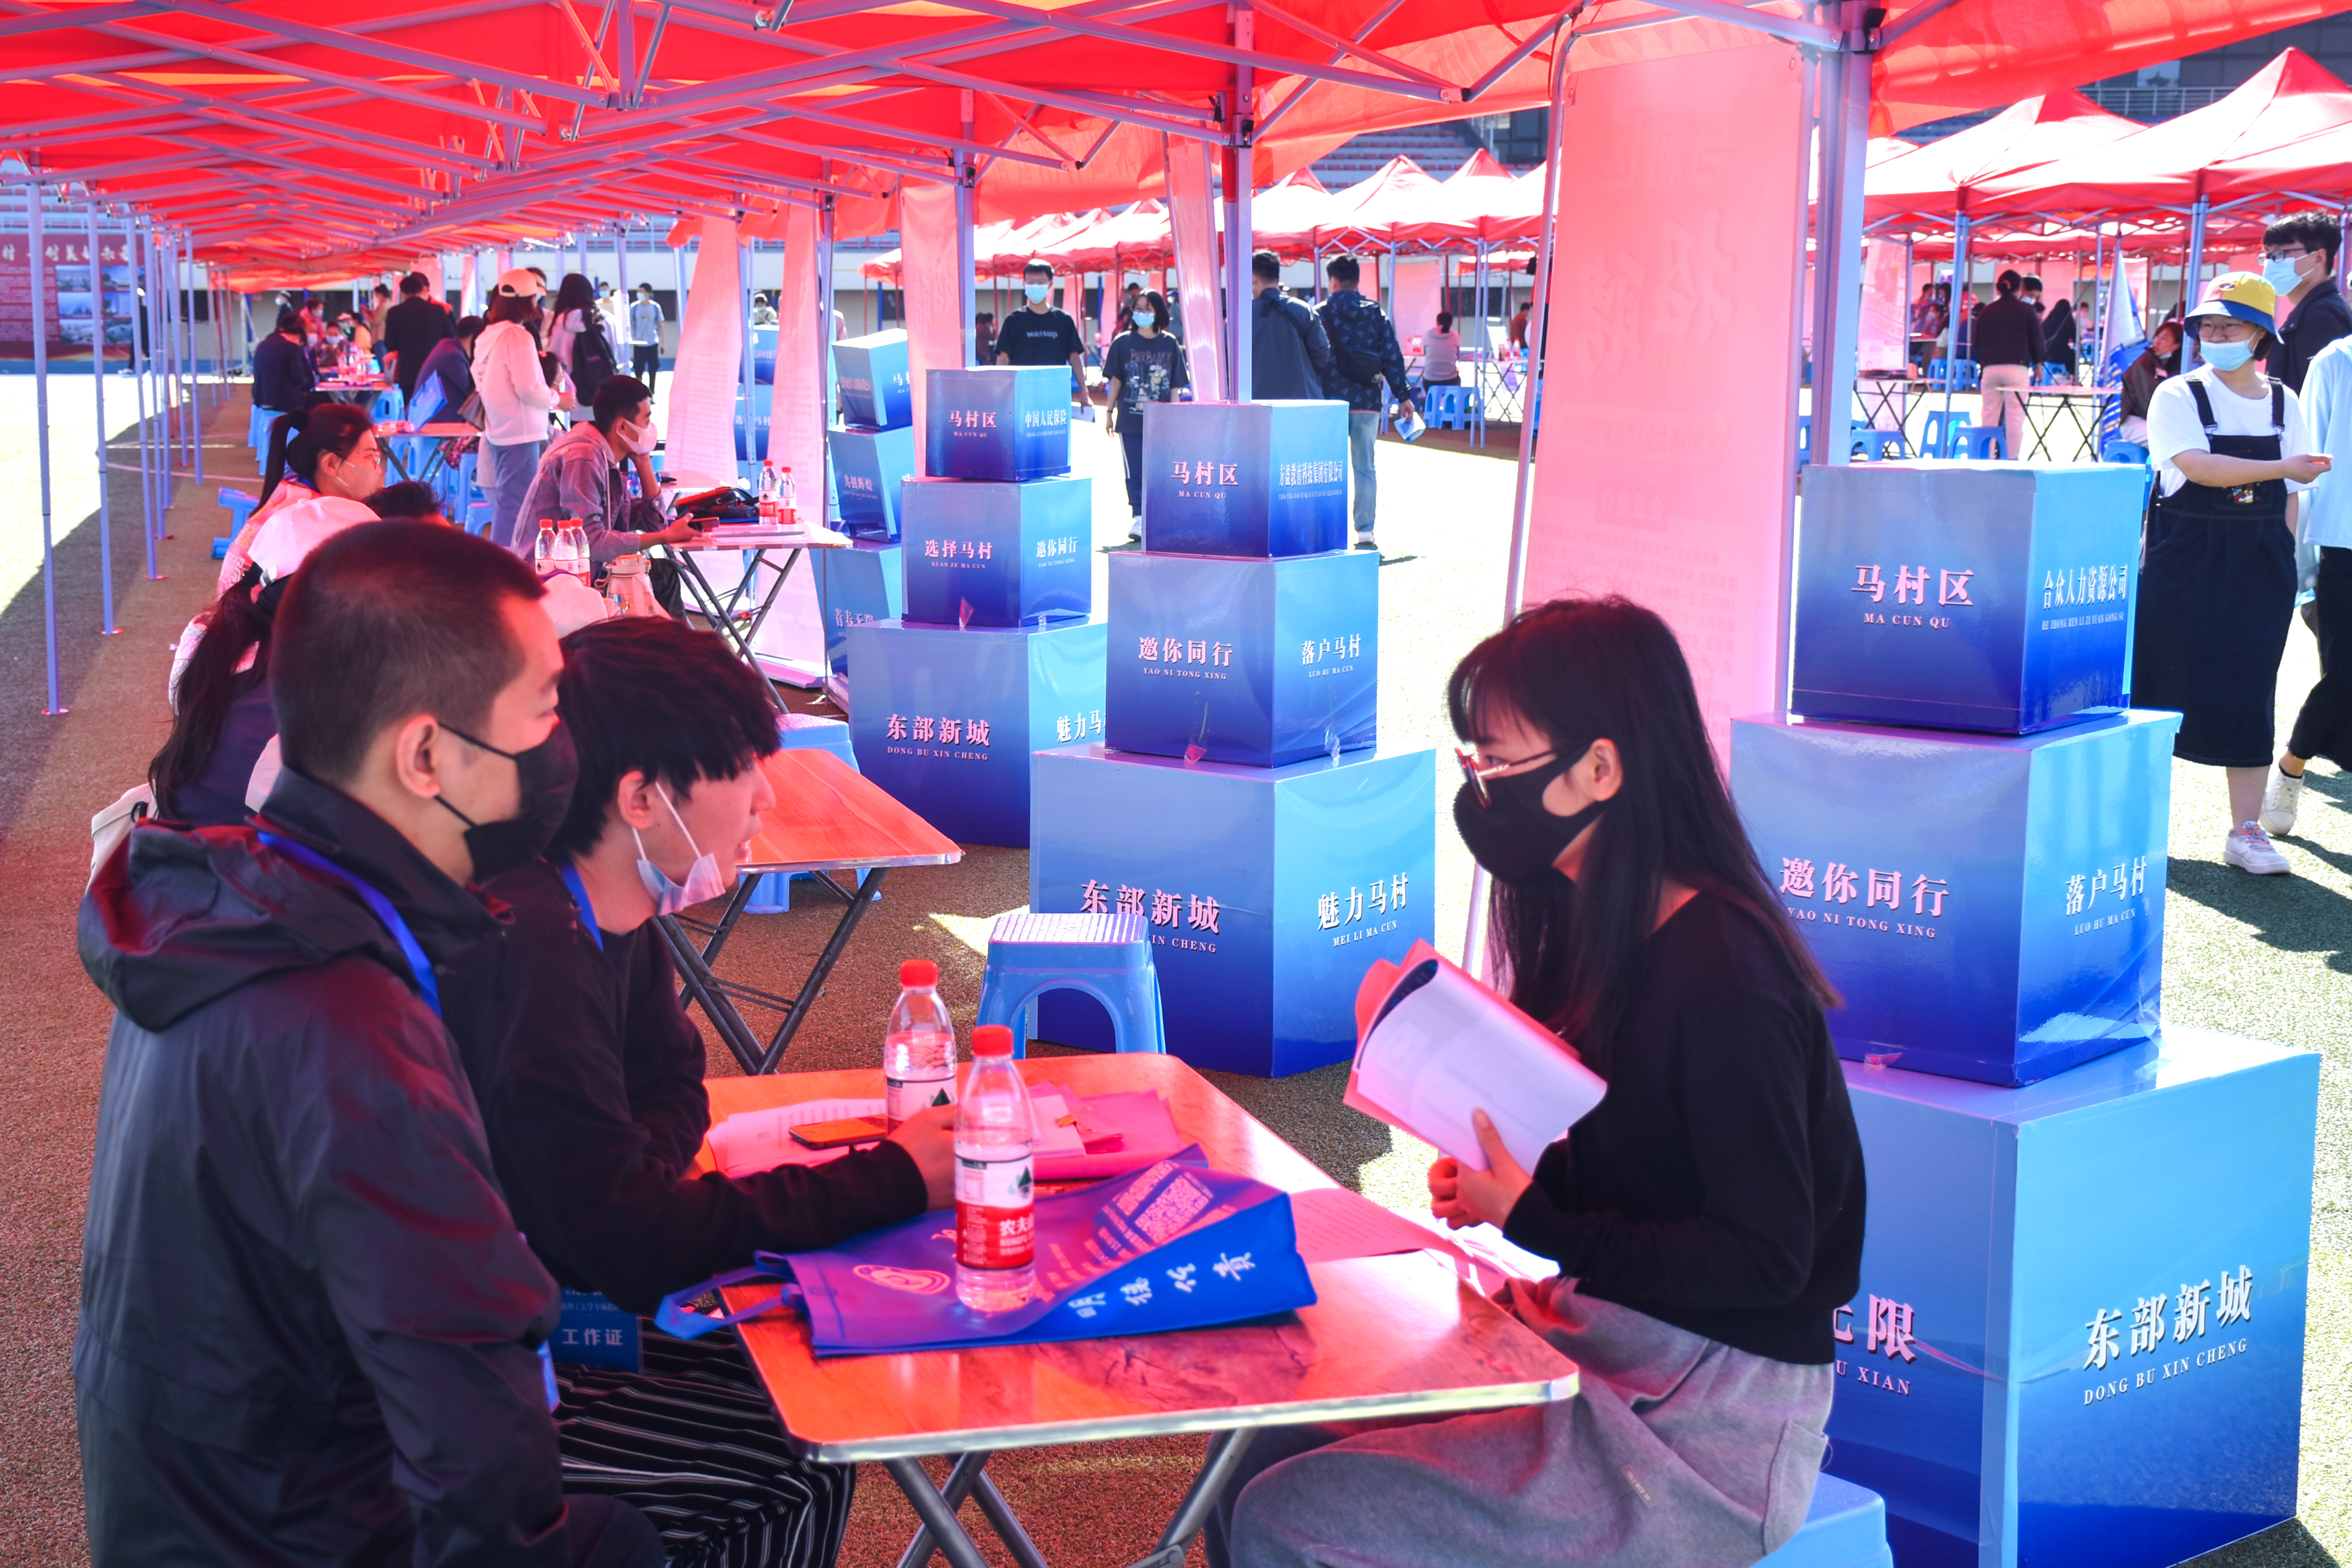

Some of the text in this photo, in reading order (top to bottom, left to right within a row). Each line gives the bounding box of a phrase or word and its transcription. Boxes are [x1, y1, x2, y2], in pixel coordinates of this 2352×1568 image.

[1026, 330, 1058, 339] wassup
[948, 410, 997, 429] 马村区
[1025, 409, 1067, 428] 中国人民保险
[1171, 461, 1239, 486] 马村区
[1193, 491, 1211, 499] CUN
[1214, 492, 1225, 500] QU
[924, 538, 993, 562] 选择马村
[1036, 536, 1078, 558] 邀你同行
[1850, 564, 1975, 607] 马村区
[2043, 563, 2128, 611] 合众人力资源公司
[1864, 612, 1951, 628] MA CUN QU
[1138, 636, 1233, 668] 邀你同行
[1301, 633, 1362, 666] 落户马村
[1143, 667, 1226, 680] YAO NI TONG XING
[1309, 670, 1320, 678] LUO
[1332, 667, 1340, 675] MA
[1341, 665, 1353, 673] CUN
[886, 713, 991, 747] 东部新城
[1056, 709, 1106, 743] 魅力马
[887, 746, 988, 762] DONG BU XIN CHENG
[1779, 857, 1950, 918] 邀你同行
[2064, 855, 2148, 917] 落户马村
[1079, 878, 1221, 935] 东部新城
[1317, 871, 1409, 931] 魅力马村
[1332, 920, 1396, 947] MEI LI MA CUN
[1787, 908, 1935, 938] YAO NI TONG XING
[2074, 908, 2135, 936] LUO HU MA CUN
[1149, 935, 1216, 953] IN CHENG
[1068, 1251, 1257, 1319] 明德任责
[2083, 1264, 2254, 1372] 东部新城
[562, 1328, 623, 1346] 工作证
[1834, 1359, 1912, 1396] U XIAN
[2084, 1337, 2246, 1406] DONG BU XIN CHENG
